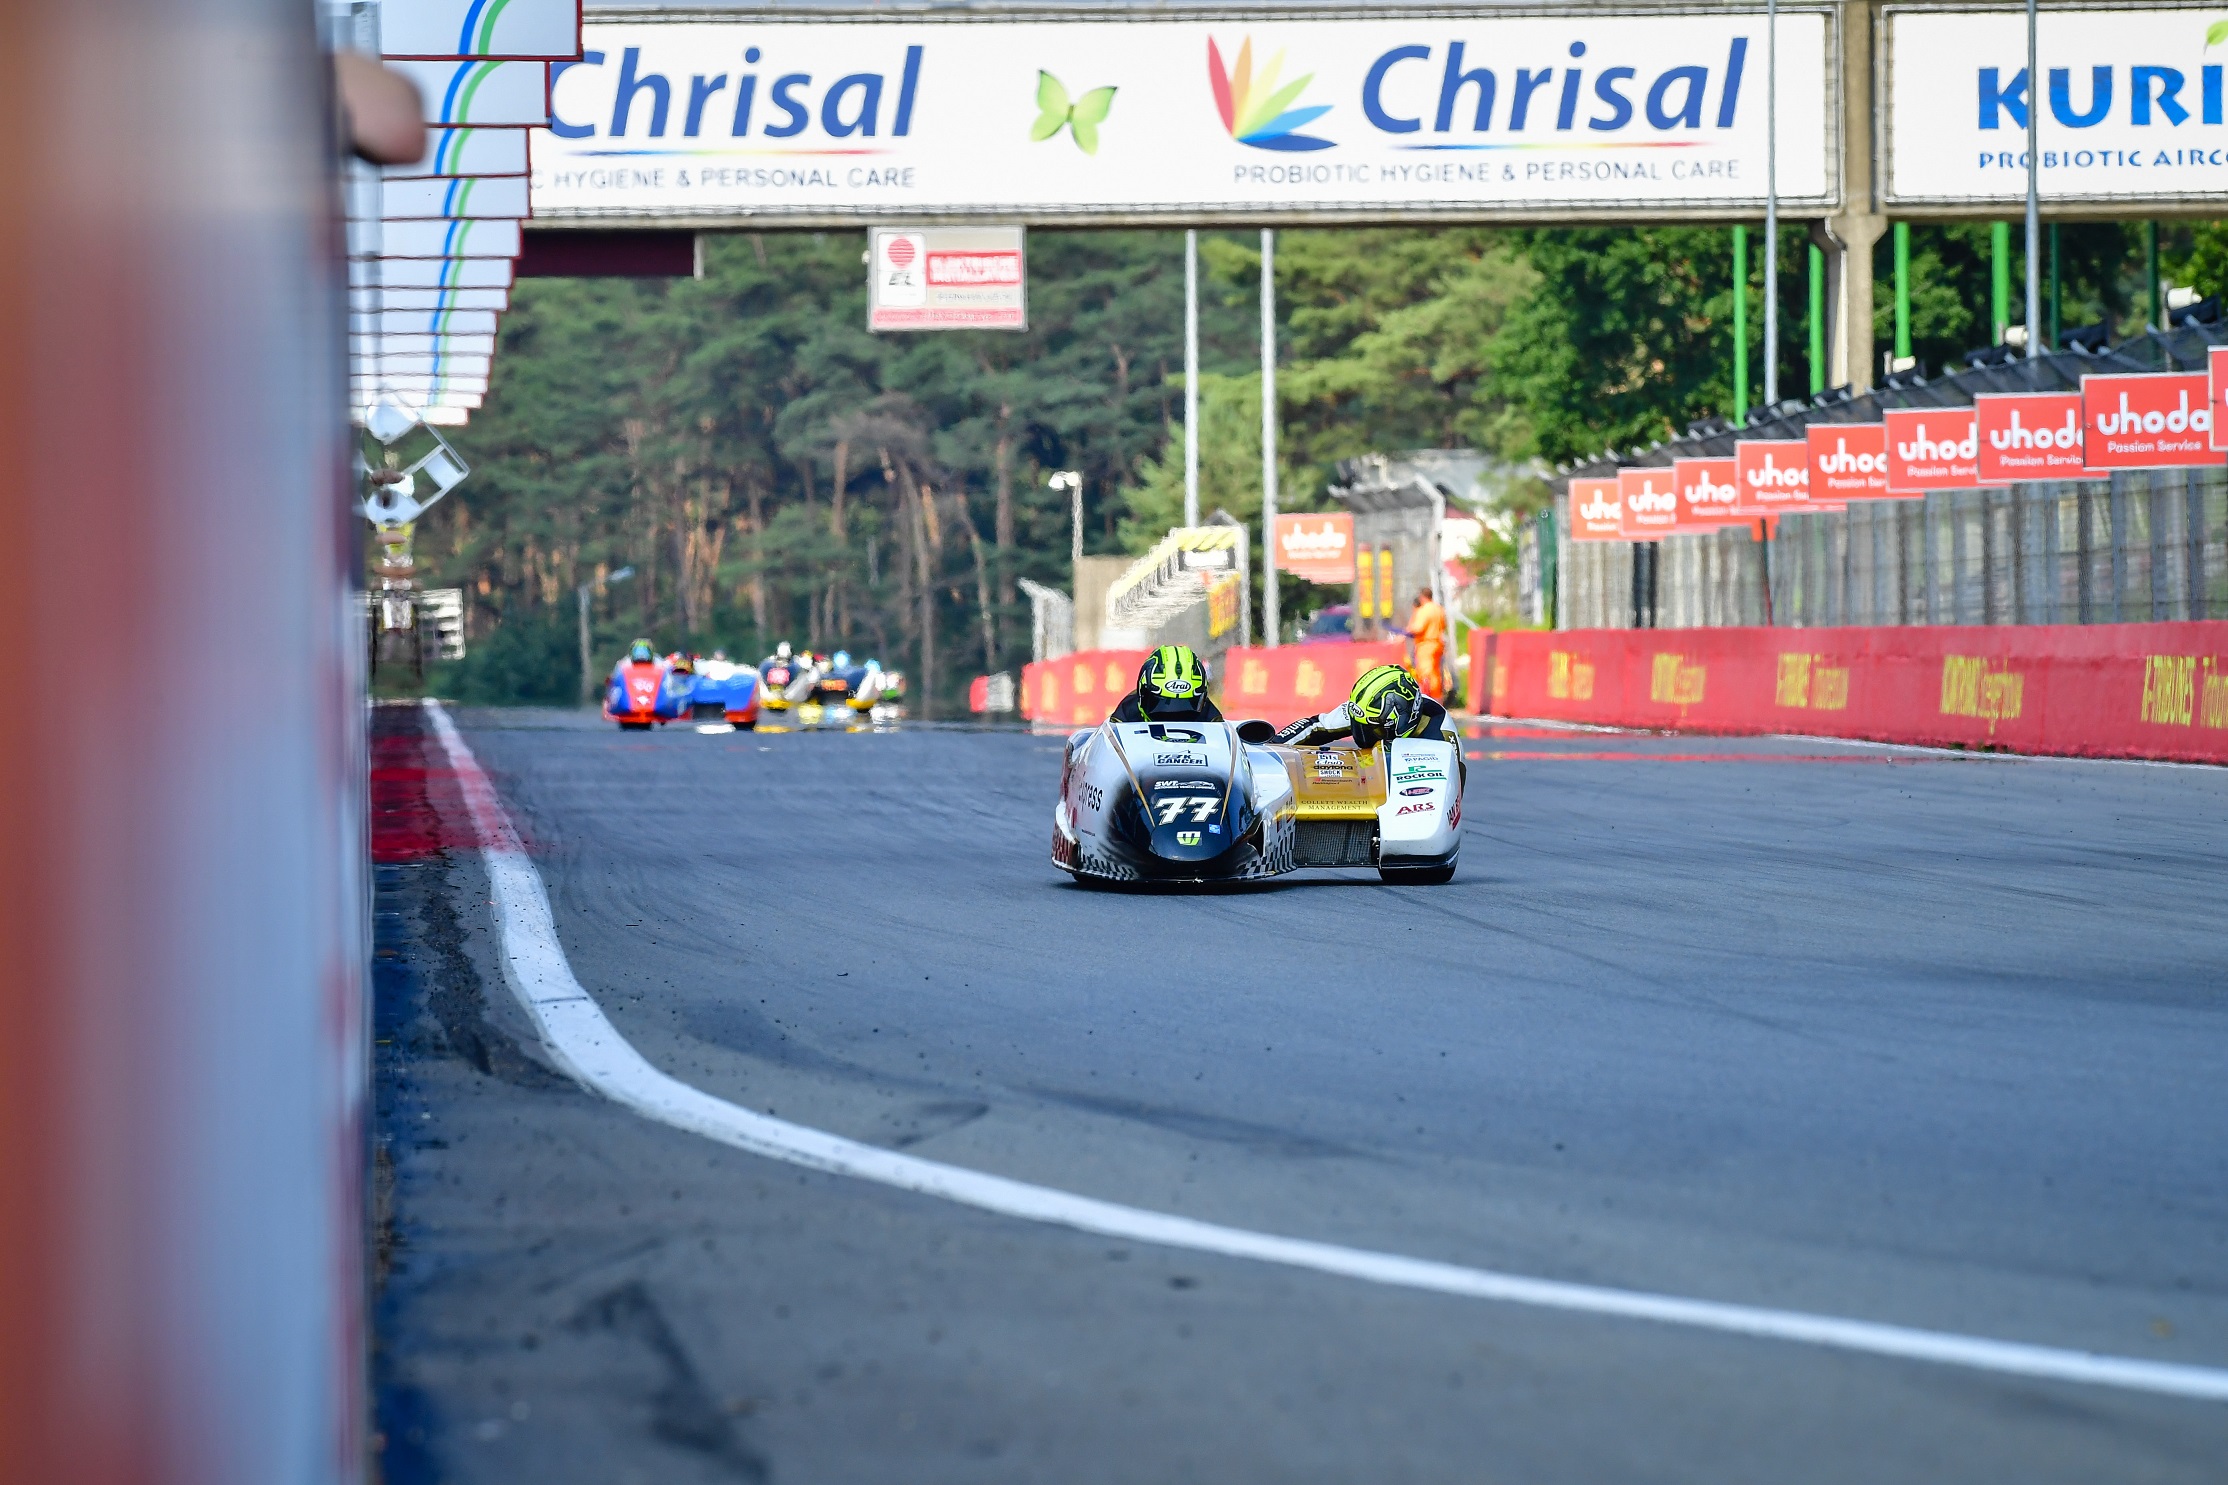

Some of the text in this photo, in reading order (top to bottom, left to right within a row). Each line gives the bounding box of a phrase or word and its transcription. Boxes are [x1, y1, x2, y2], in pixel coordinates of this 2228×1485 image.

[547, 45, 923, 139] Chrisal
[1362, 37, 1749, 133] Chrisal
[1978, 64, 2223, 130] KURI
[2153, 149, 2228, 167] AIRC
[554, 168, 664, 189] HYGIENE
[676, 168, 691, 187] &
[702, 167, 837, 188] PERSONAL
[849, 167, 915, 187] CARE
[1234, 159, 1740, 185] PROBIOTIC HYGIENE & PERSONAL CARE
[2107, 439, 2202, 453] Passion Service
[2001, 454, 2044, 466] Passion
[1168, 681, 1189, 690] Arai
[1349, 702, 1363, 716] Arai
[1396, 773, 1426, 781] ROCK
[1154, 796, 1221, 826] 77
[1395, 802, 1435, 816] ARS
